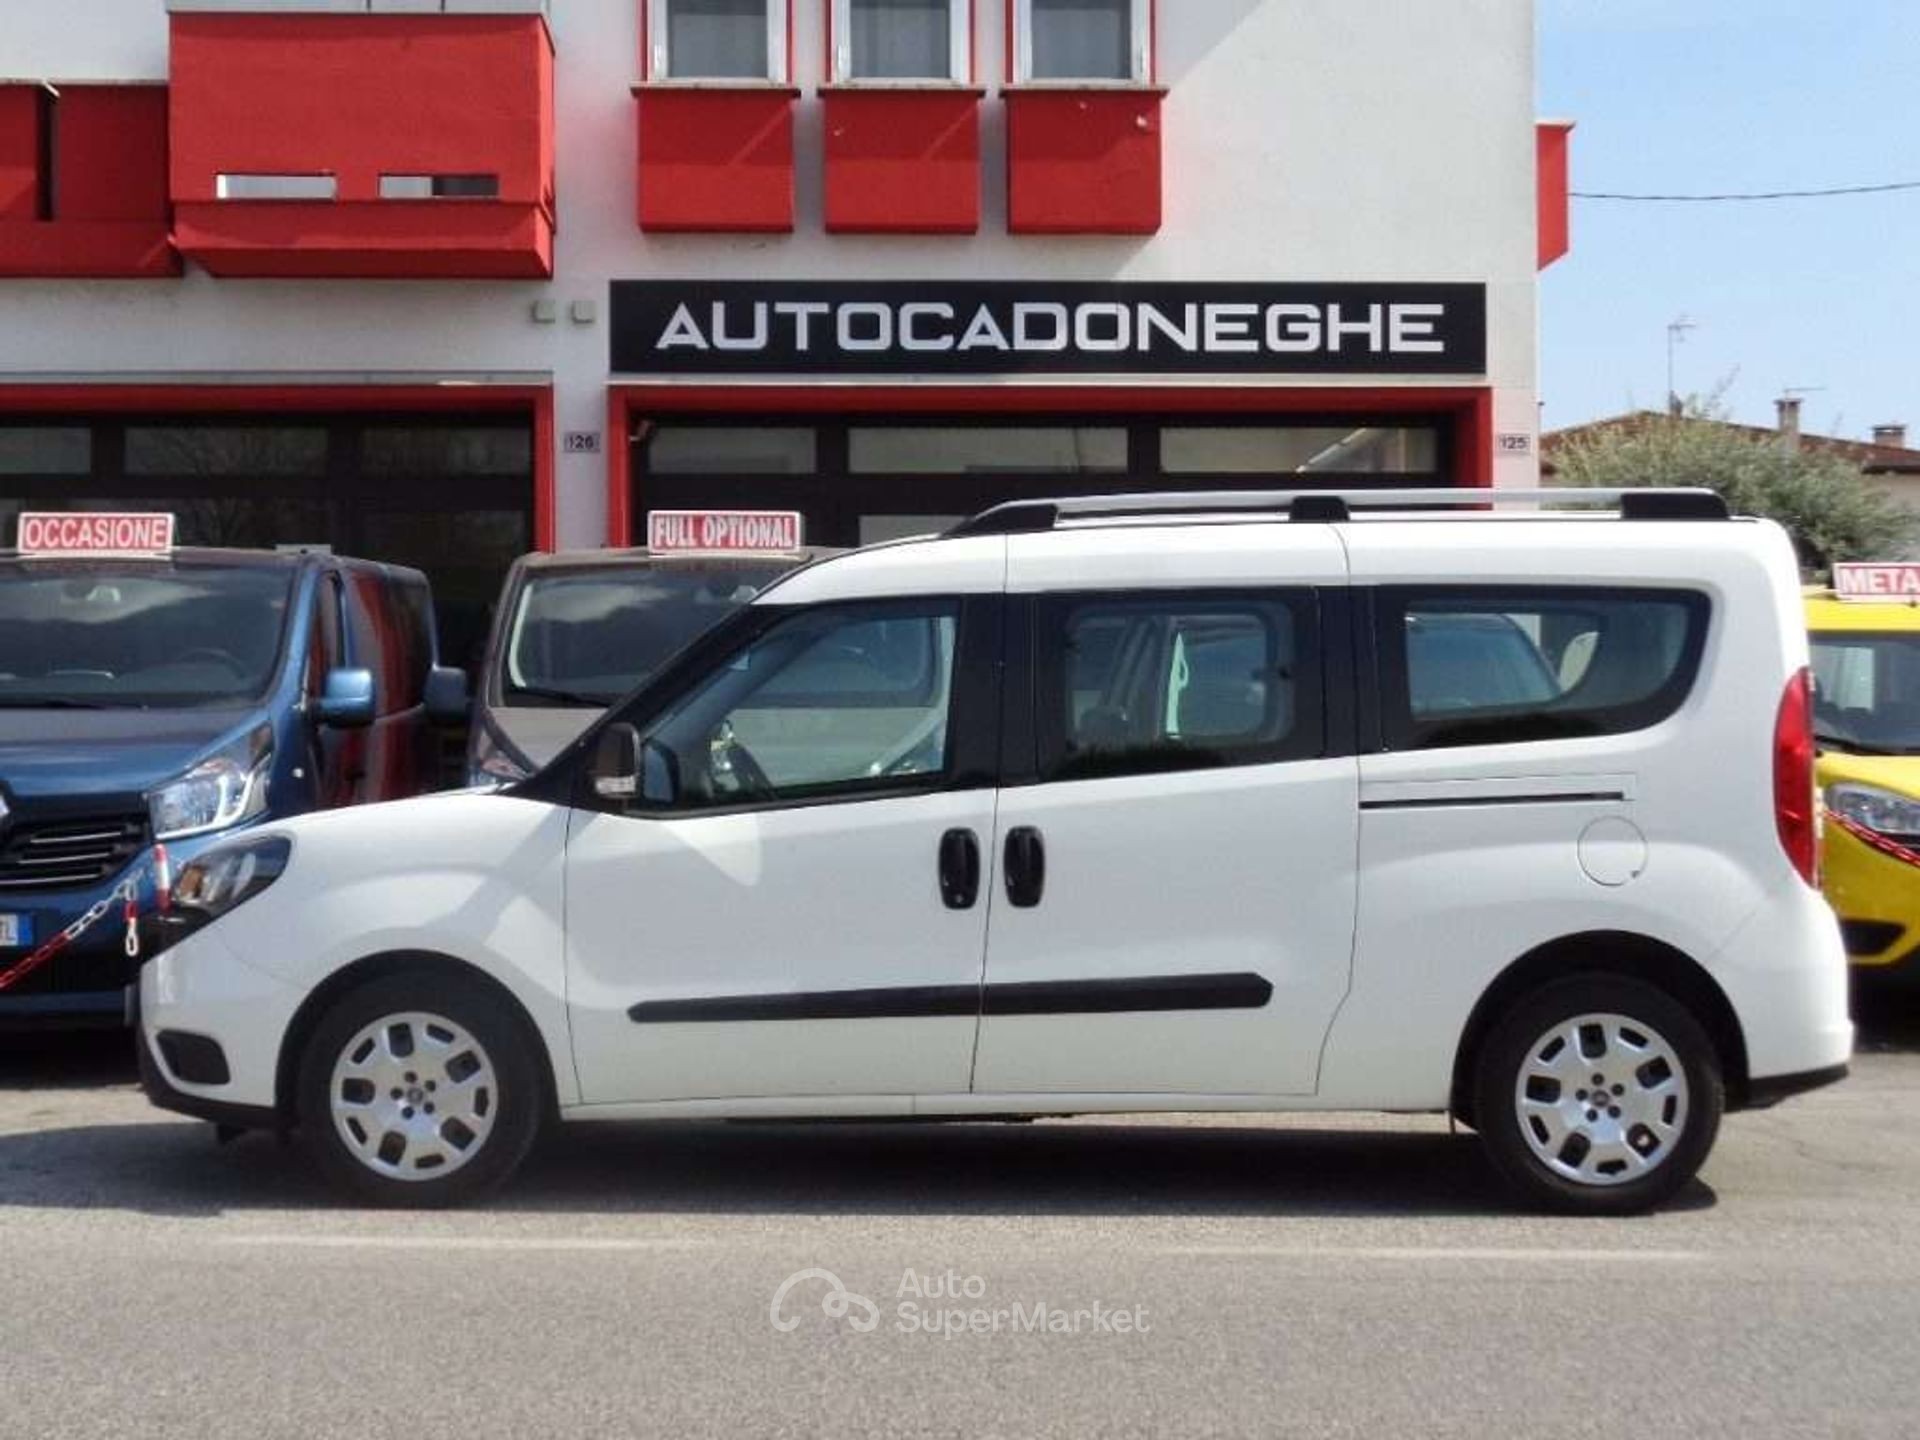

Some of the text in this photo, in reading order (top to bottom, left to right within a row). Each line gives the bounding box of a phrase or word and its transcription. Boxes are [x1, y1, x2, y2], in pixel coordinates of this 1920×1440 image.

[655, 301, 1444, 352] AUTOCADONEGHE
[1501, 436, 1527, 449] 125
[25, 518, 168, 548] OCCASIONE
[654, 515, 793, 547] FULL OPTIONAL
